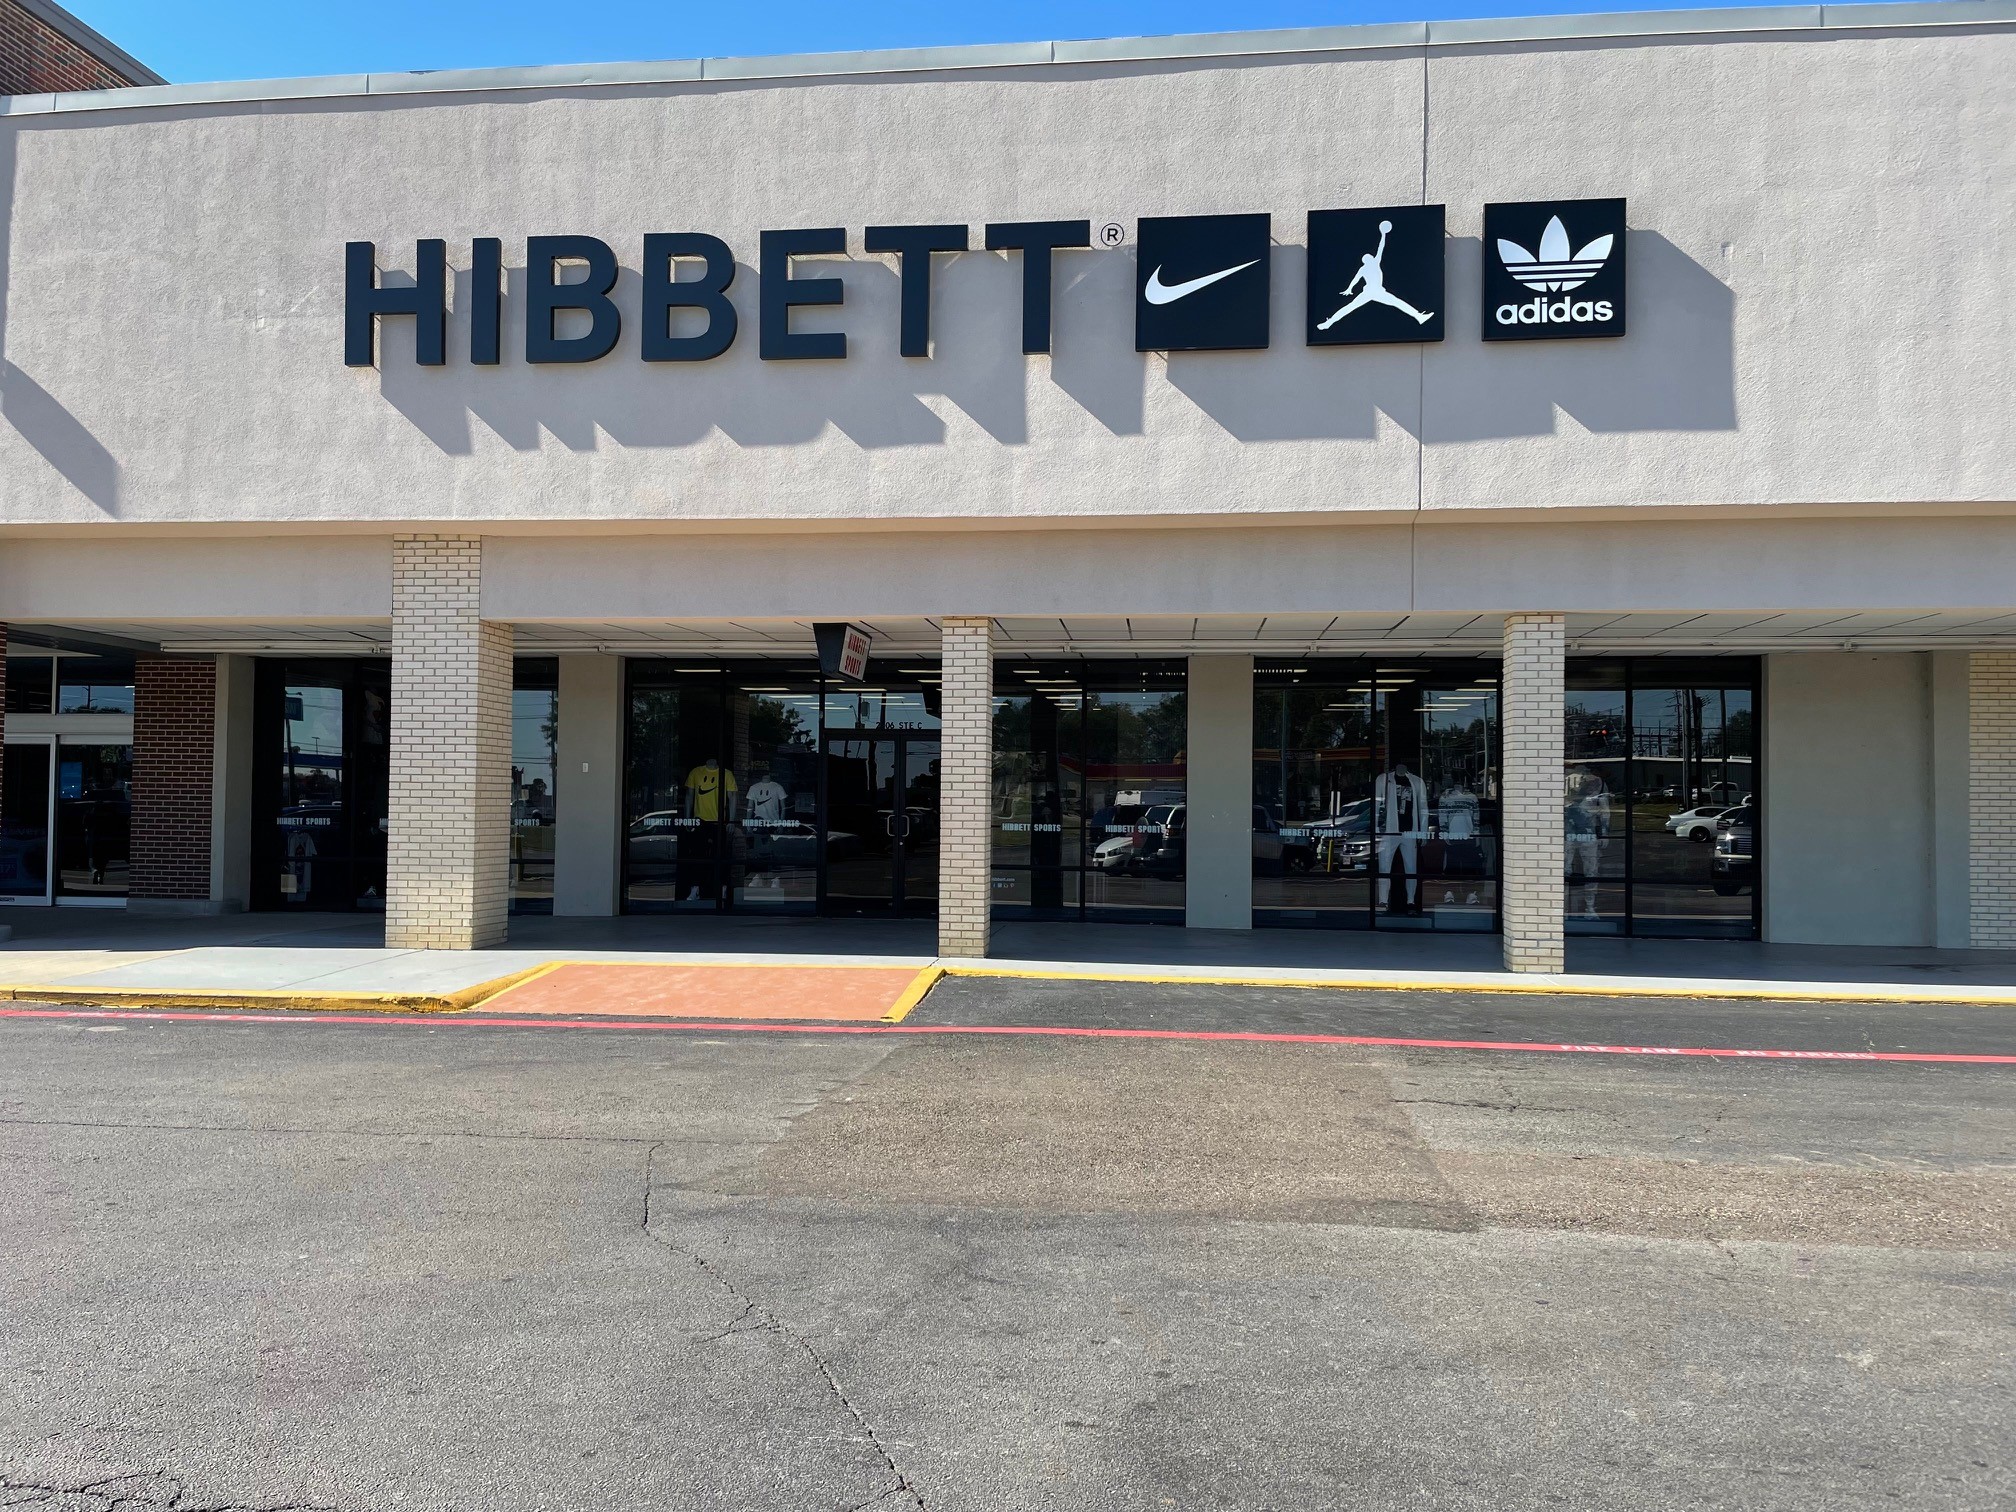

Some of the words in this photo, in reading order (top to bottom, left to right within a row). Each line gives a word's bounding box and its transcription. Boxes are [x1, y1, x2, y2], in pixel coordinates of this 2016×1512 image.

[345, 220, 1090, 367] HIBBETT
[1496, 296, 1614, 325] adidas
[898, 721, 914, 730] STE
[305, 817, 331, 825] SPORTS
[514, 818, 540, 826] SPORTS
[644, 818, 671, 826] HIBBETT
[674, 818, 700, 826] SPORTS
[742, 819, 770, 827] HIBBETT
[773, 819, 800, 827] SPORTS
[1002, 823, 1031, 831] HIBBETT
[1033, 823, 1062, 832] SPORTS
[1105, 824, 1134, 833] HIBBETT
[1137, 825, 1166, 833] SPORTS
[1279, 828, 1310, 837] HIBBETT
[1313, 829, 1343, 838] SPORTS
[1567, 833, 1597, 842] SPORTS
